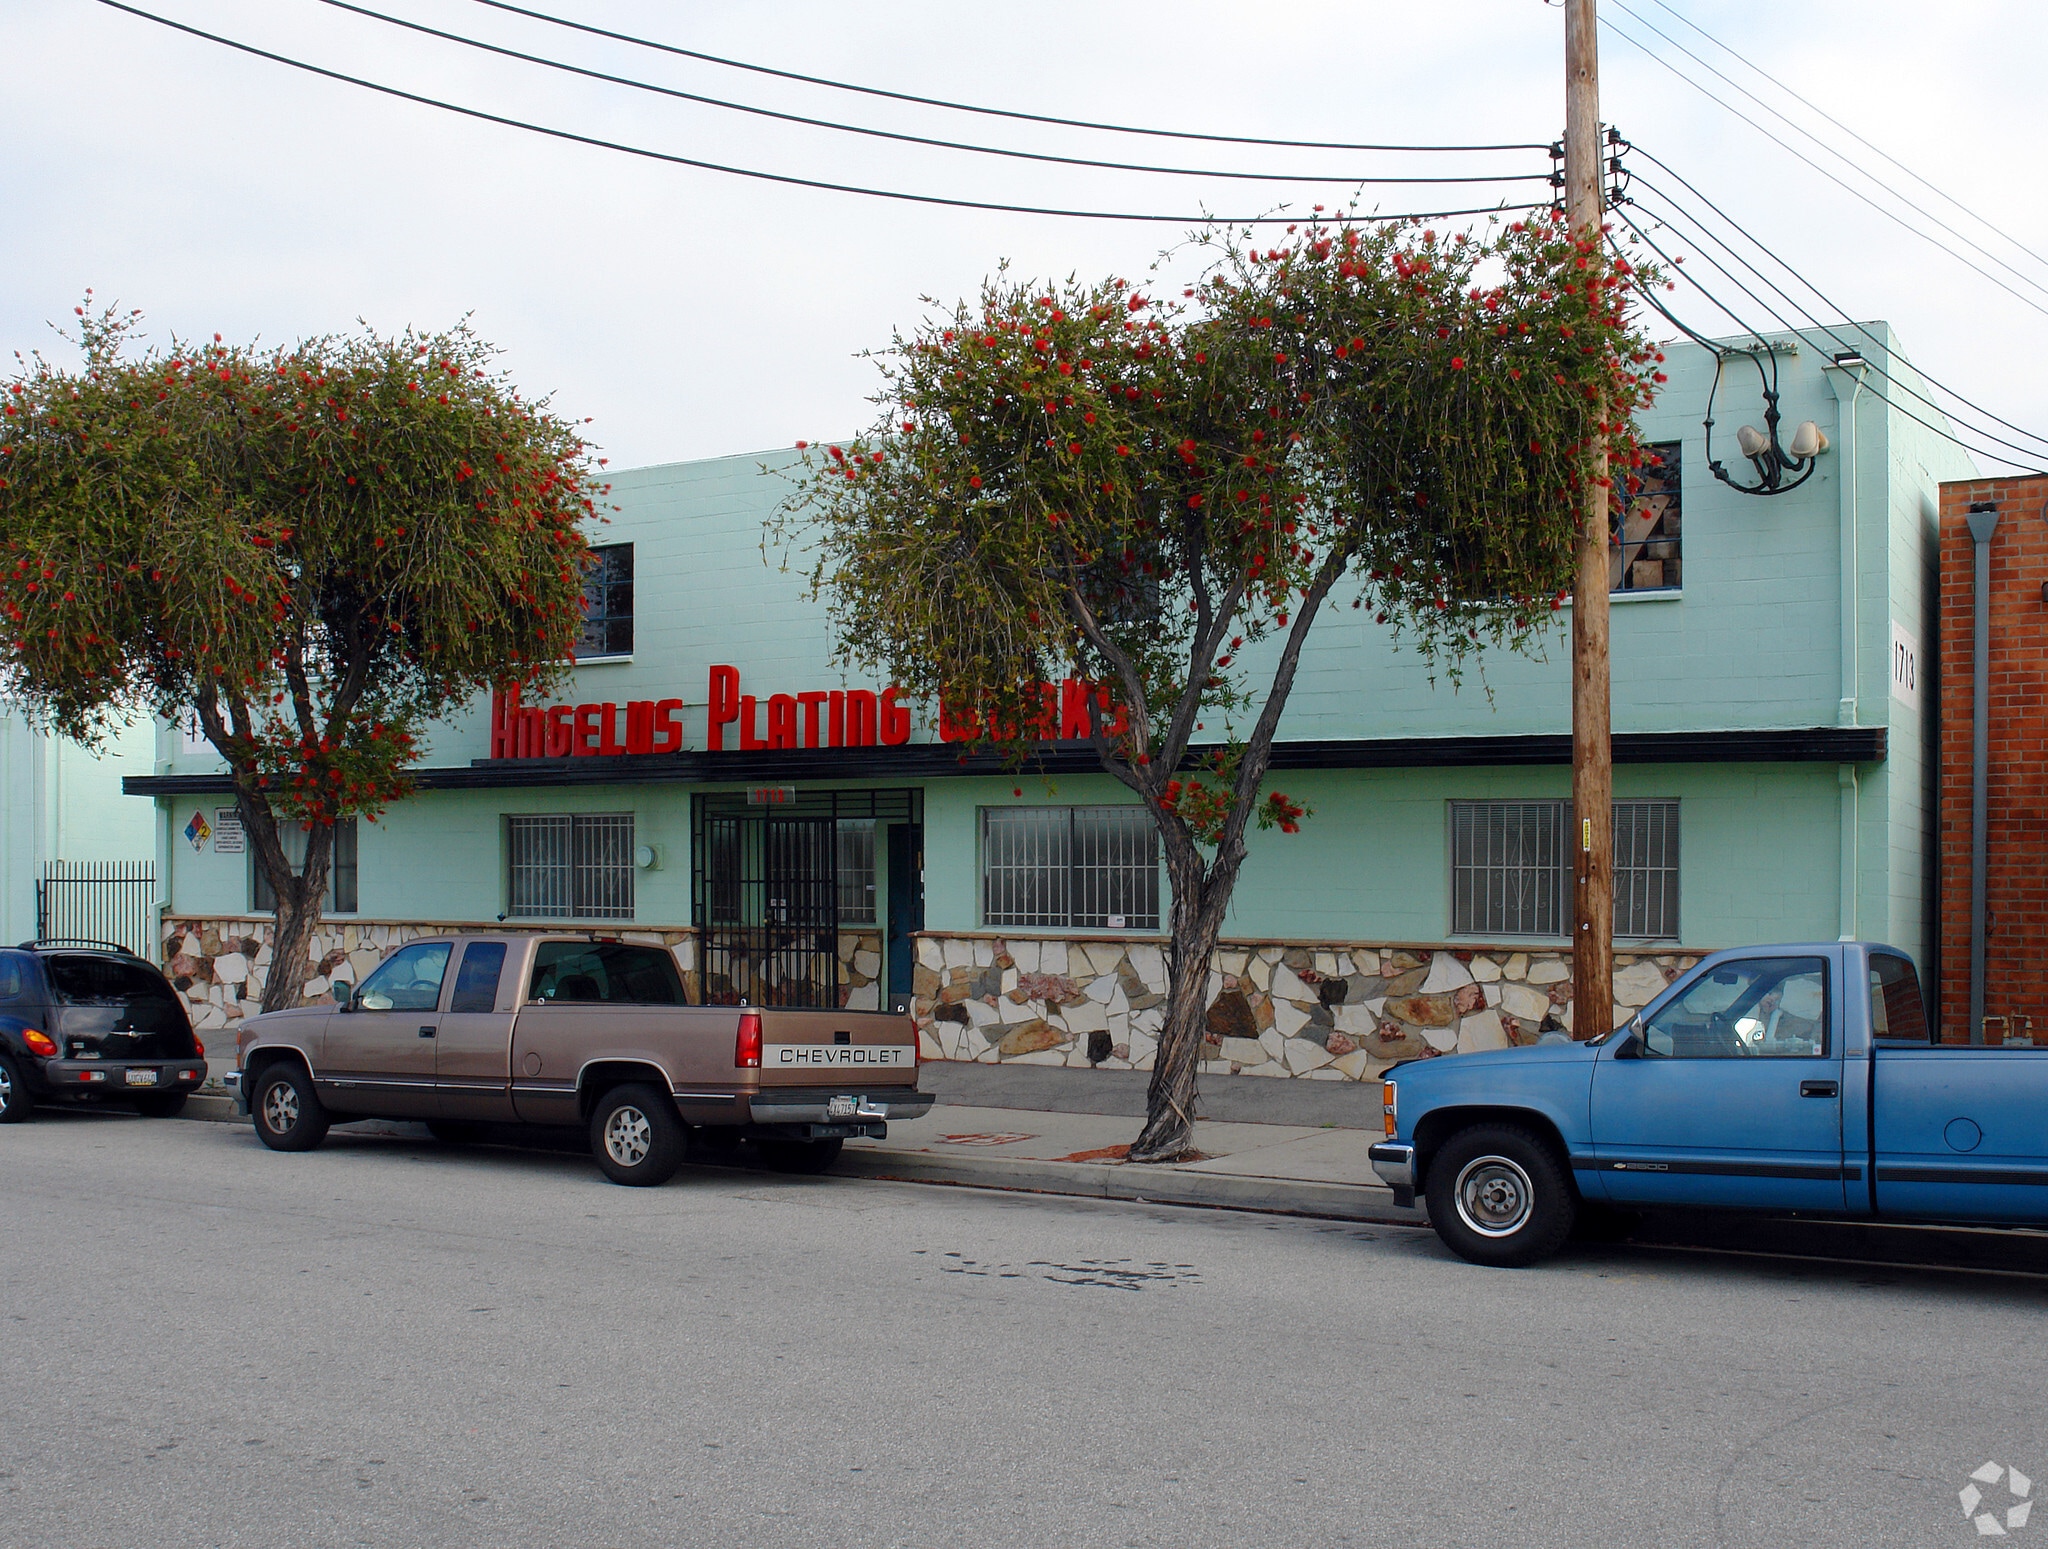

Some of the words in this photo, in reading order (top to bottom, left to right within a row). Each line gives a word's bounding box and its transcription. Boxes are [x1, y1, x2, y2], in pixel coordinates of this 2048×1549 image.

[1894, 640, 1915, 691] 1713
[491, 681, 683, 760] ANGELUS
[708, 664, 911, 752] PLATING
[201, 825, 207, 838] 2
[780, 1049, 902, 1063] CHEVROLET
